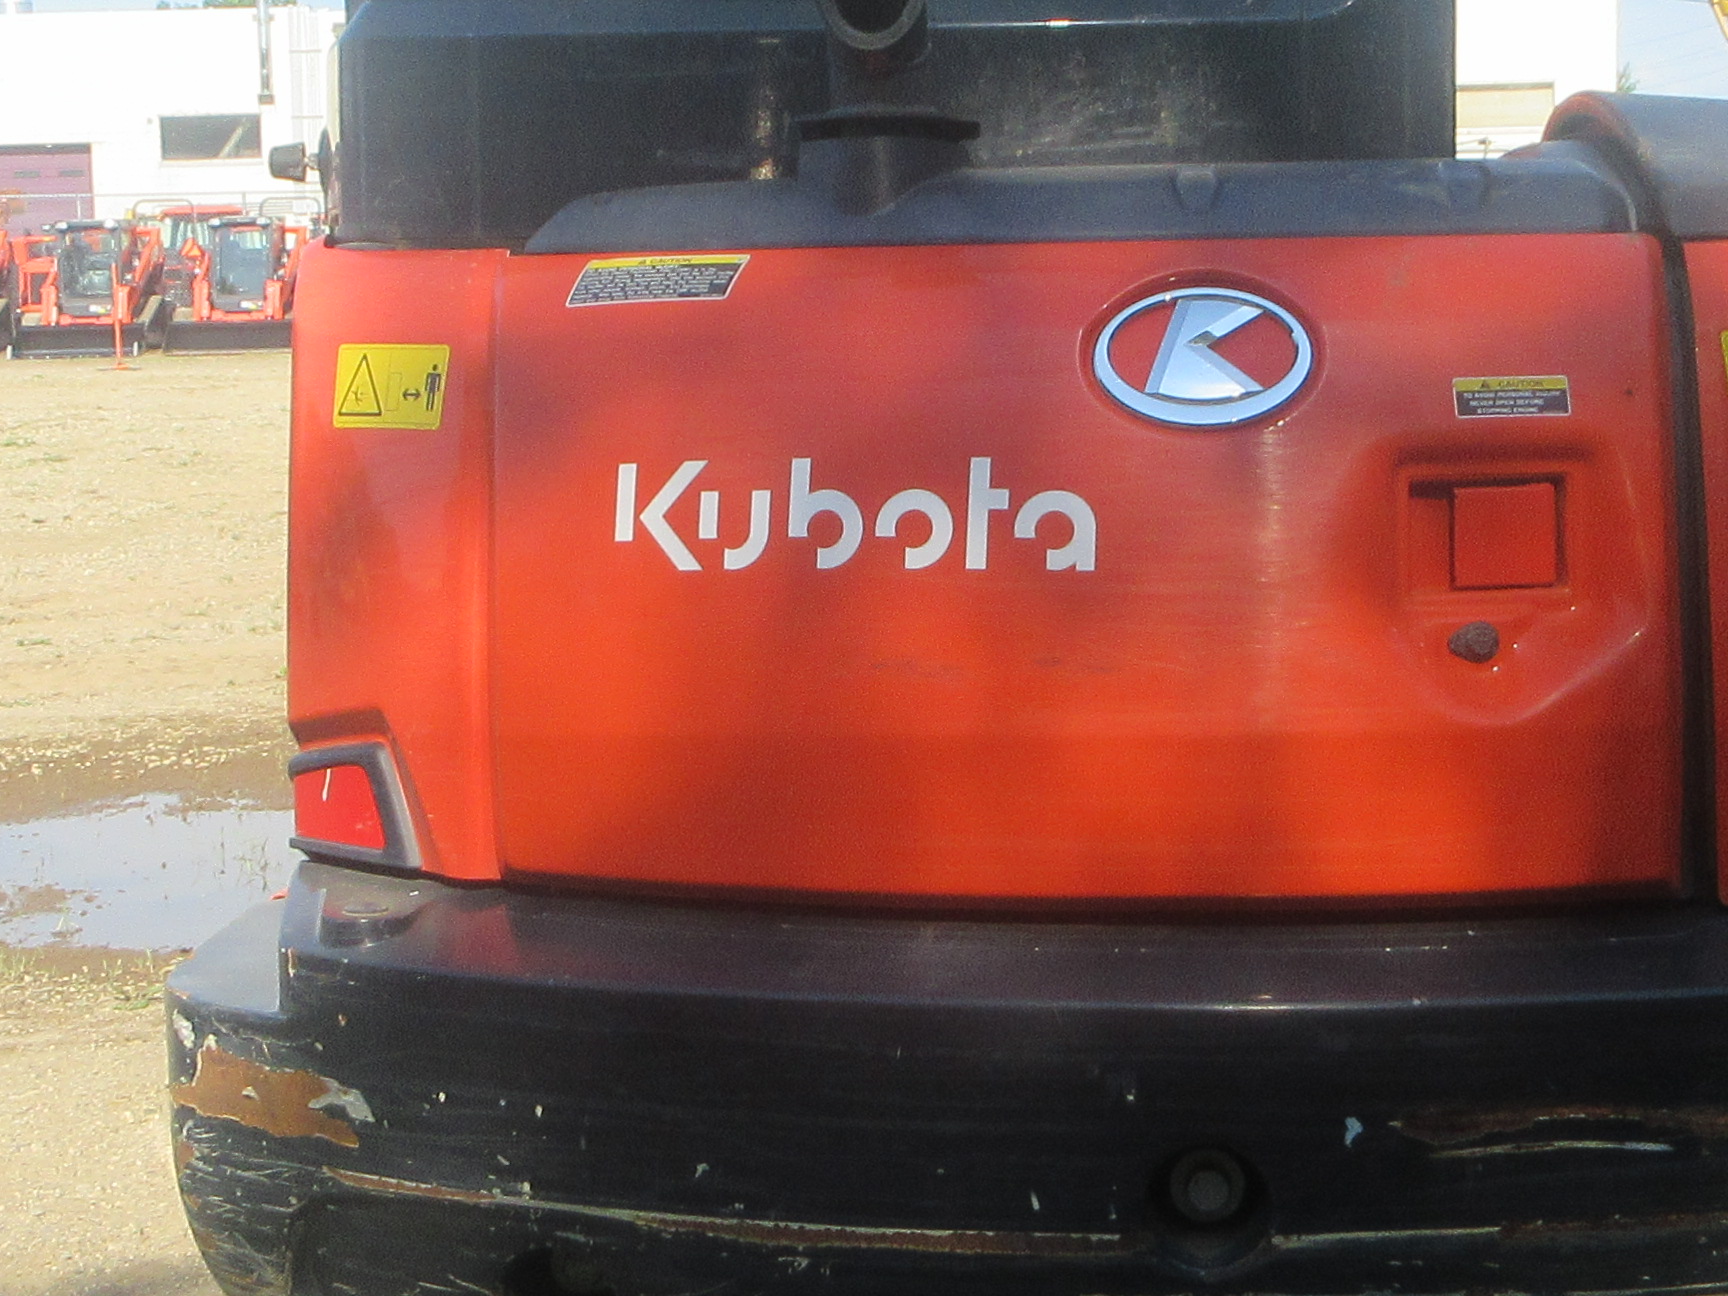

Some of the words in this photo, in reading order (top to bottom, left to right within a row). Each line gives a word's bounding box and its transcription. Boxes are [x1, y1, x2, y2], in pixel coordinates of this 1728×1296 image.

[650, 257, 693, 265] CAUTION
[1498, 379, 1544, 388] CAUTION
[613, 456, 1098, 571] Kubota
